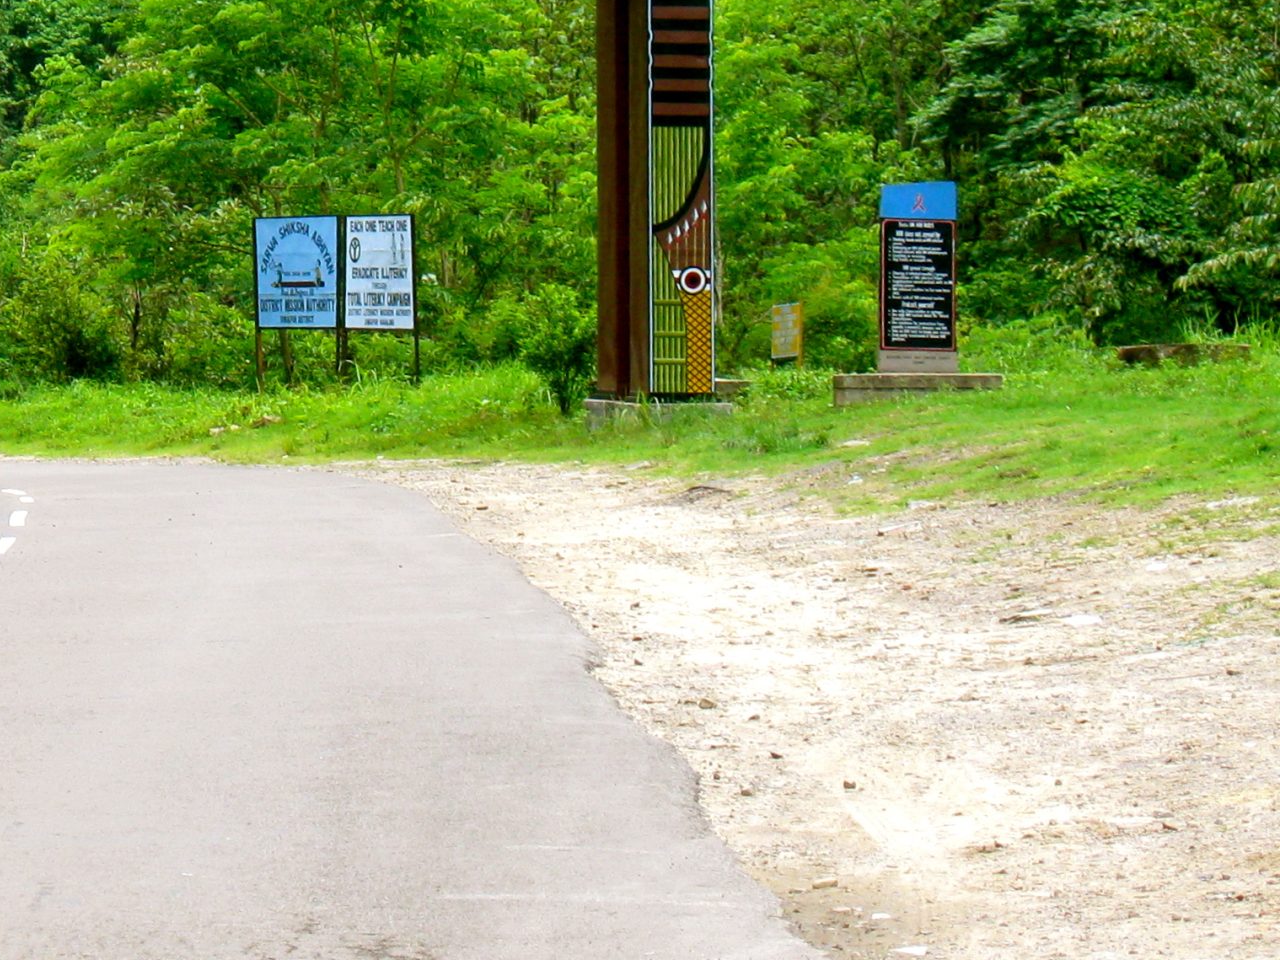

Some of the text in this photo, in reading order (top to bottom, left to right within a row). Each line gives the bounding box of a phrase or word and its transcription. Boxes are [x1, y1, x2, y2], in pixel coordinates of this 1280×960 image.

[350, 220, 408, 232] EACH ONE TEACH ONE
[260, 236, 279, 275] SARVA
[278, 221, 310, 240] SHIKSHA
[352, 267, 380, 280] ERADICATE
[260, 298, 282, 312] DISTRICT
[306, 298, 335, 312] AUTHORITY
[364, 292, 386, 306] LITERACY
